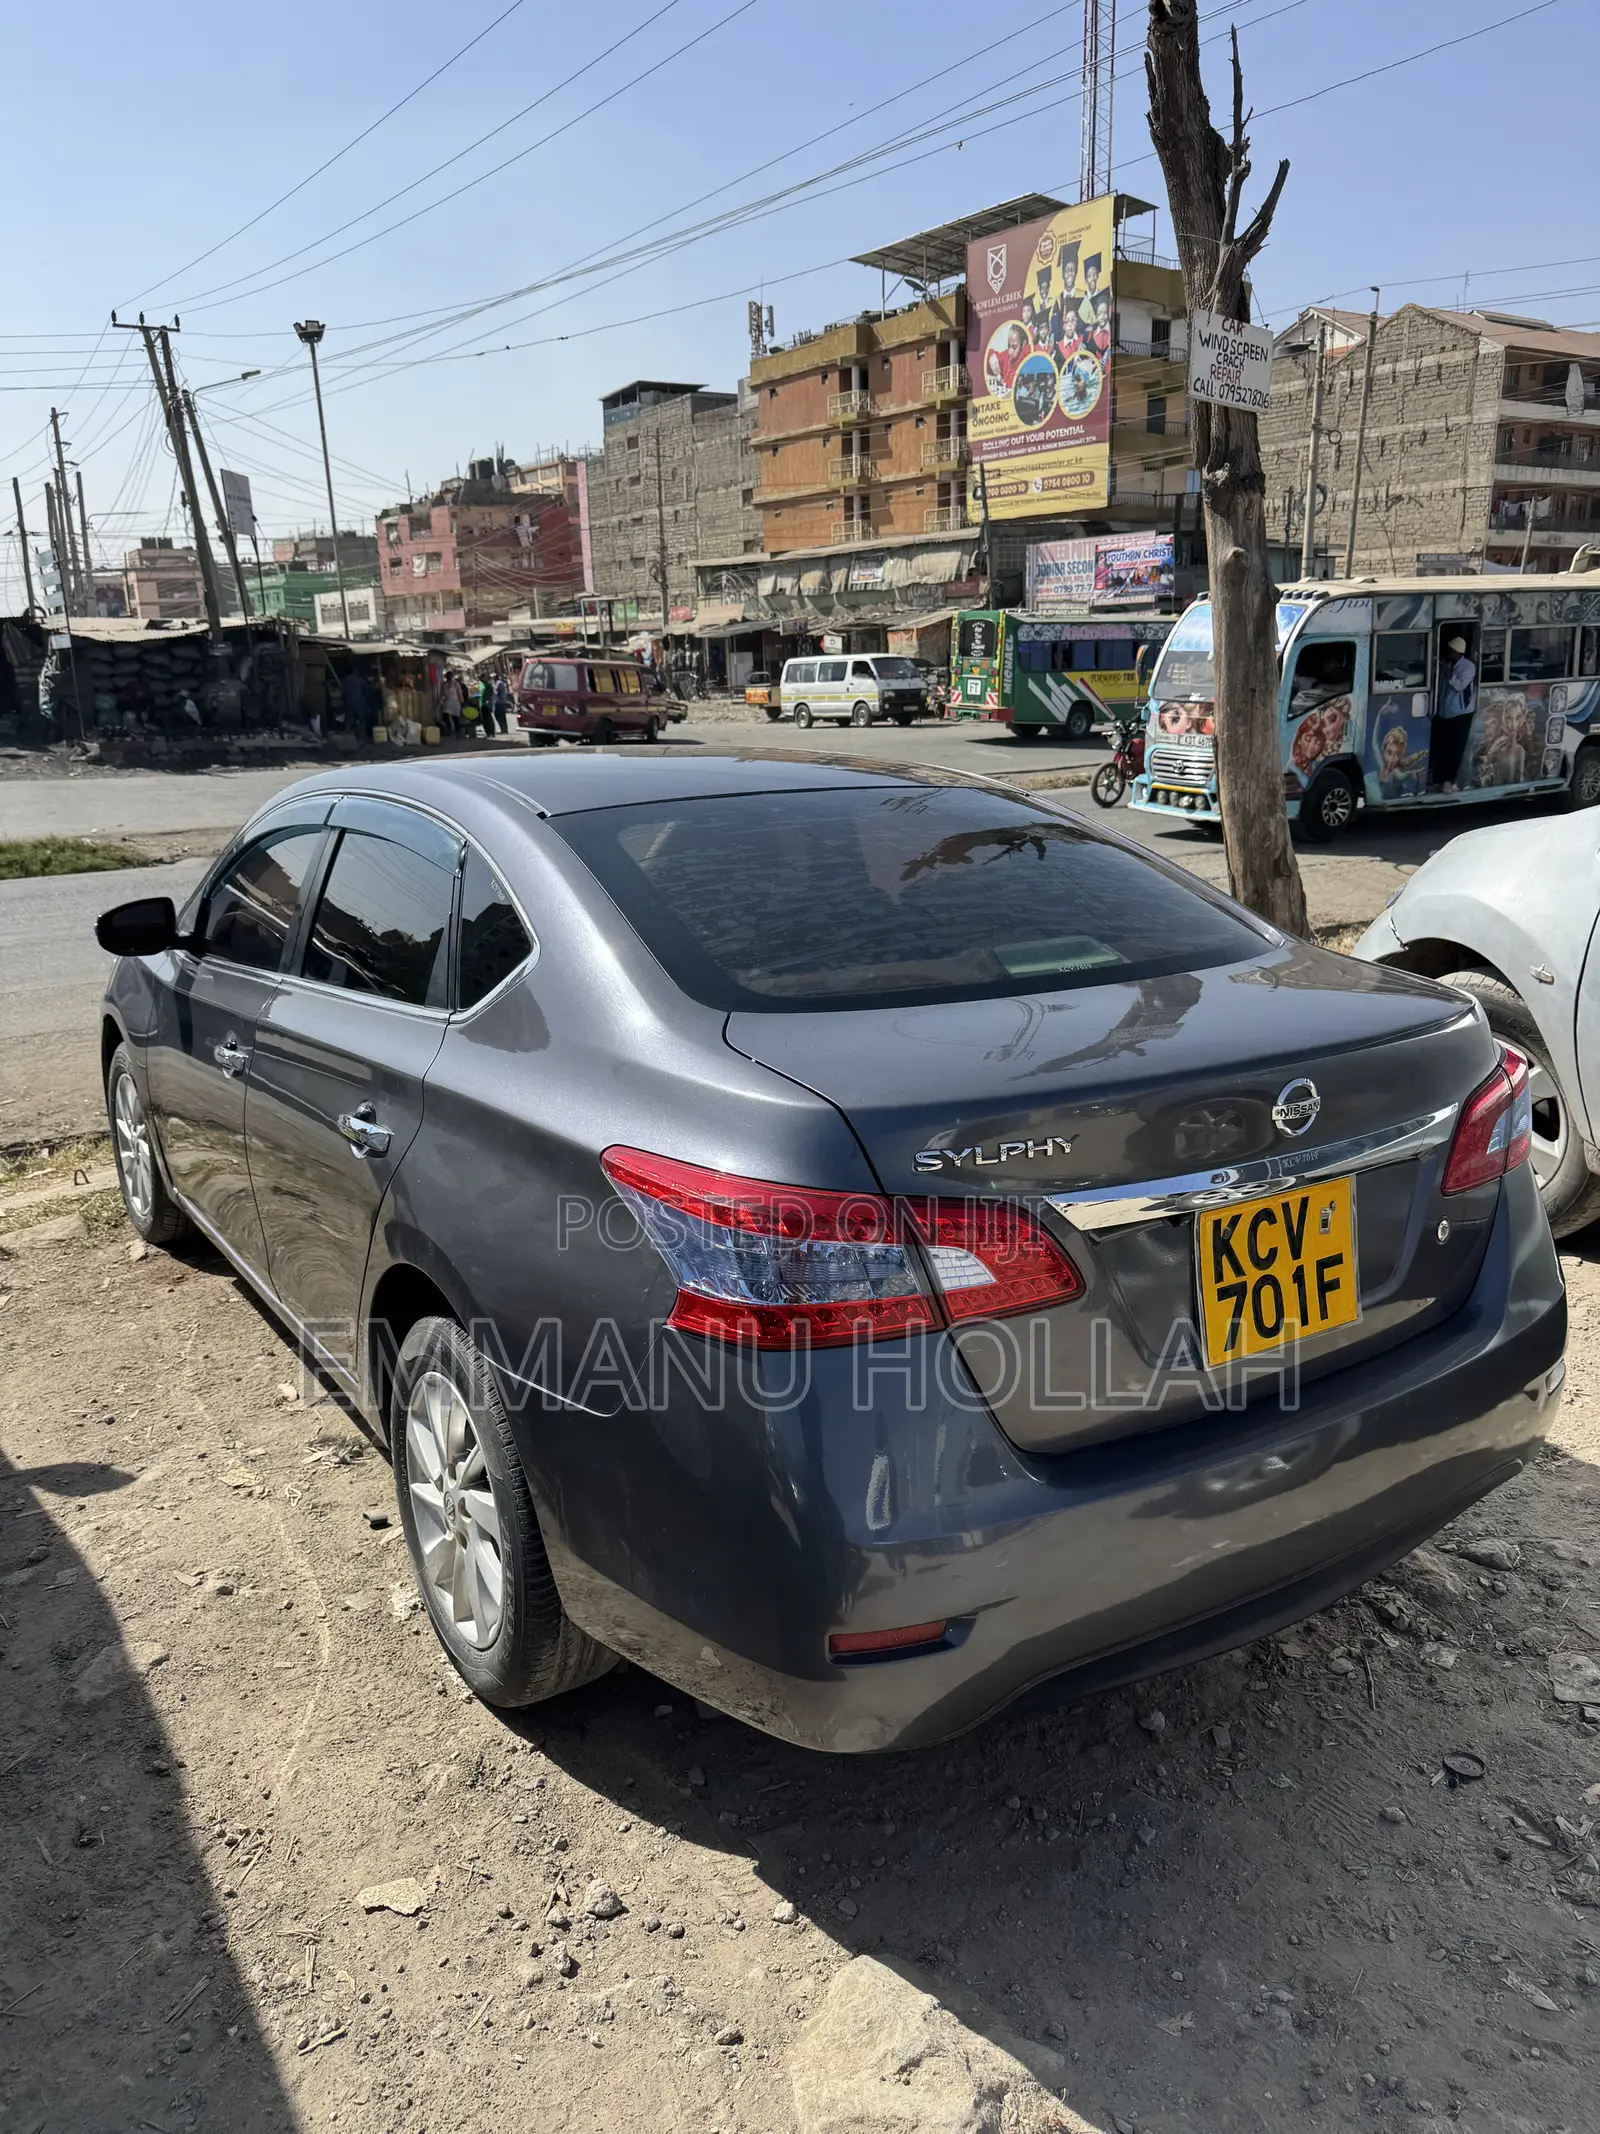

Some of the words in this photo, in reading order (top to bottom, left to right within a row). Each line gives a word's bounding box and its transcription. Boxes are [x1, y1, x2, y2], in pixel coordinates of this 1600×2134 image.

[1222, 316, 1245, 337] CAR
[1216, 352, 1246, 371] CRACK
[1210, 363, 1242, 386] REPAIR
[1218, 383, 1270, 409] 0795278216
[972, 401, 1001, 415] INTAKE
[972, 412, 1010, 427] ONGOING
[982, 438, 1010, 451] ROLLING
[1011, 435, 1025, 446] OUT
[1026, 431, 1045, 443] YOUR
[1046, 424, 1085, 440] POTENTIAL
[1082, 473, 1090, 484] 10
[1143, 547, 1171, 559] CHRIST
[1035, 562, 1066, 578] JUNIOR
[1003, 634, 1013, 695] MICHAEL
[1280, 1101, 1319, 1118] NISSAN
[912, 1134, 1079, 1173] SYLPHY
[1282, 1156, 1301, 1168] KCV
[1302, 1151, 1320, 1162] 701F
[1212, 1196, 1310, 1284] KCV
[1217, 1252, 1344, 1352] 701F
